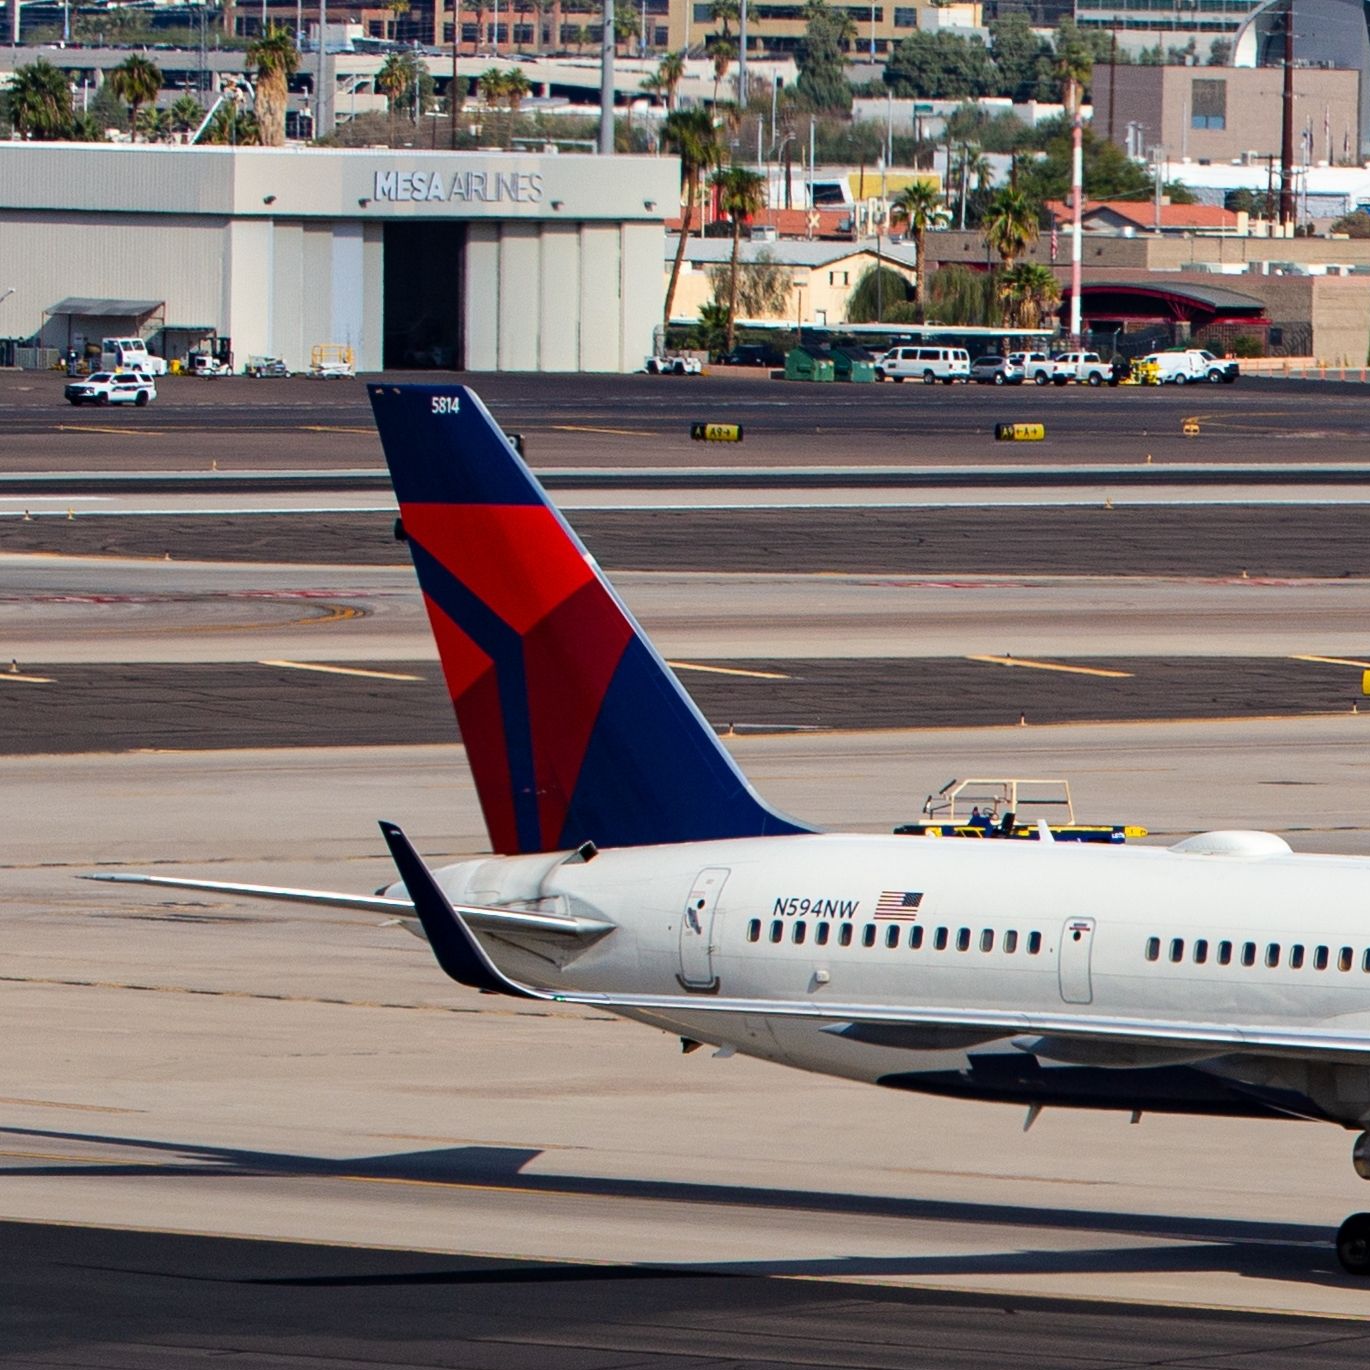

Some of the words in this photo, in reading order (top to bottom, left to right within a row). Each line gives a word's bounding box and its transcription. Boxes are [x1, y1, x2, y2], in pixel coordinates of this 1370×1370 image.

[374, 170, 446, 201] MESA
[449, 171, 544, 203] AIRLINES
[431, 396, 460, 414] 5814
[773, 897, 860, 918] N594NW
